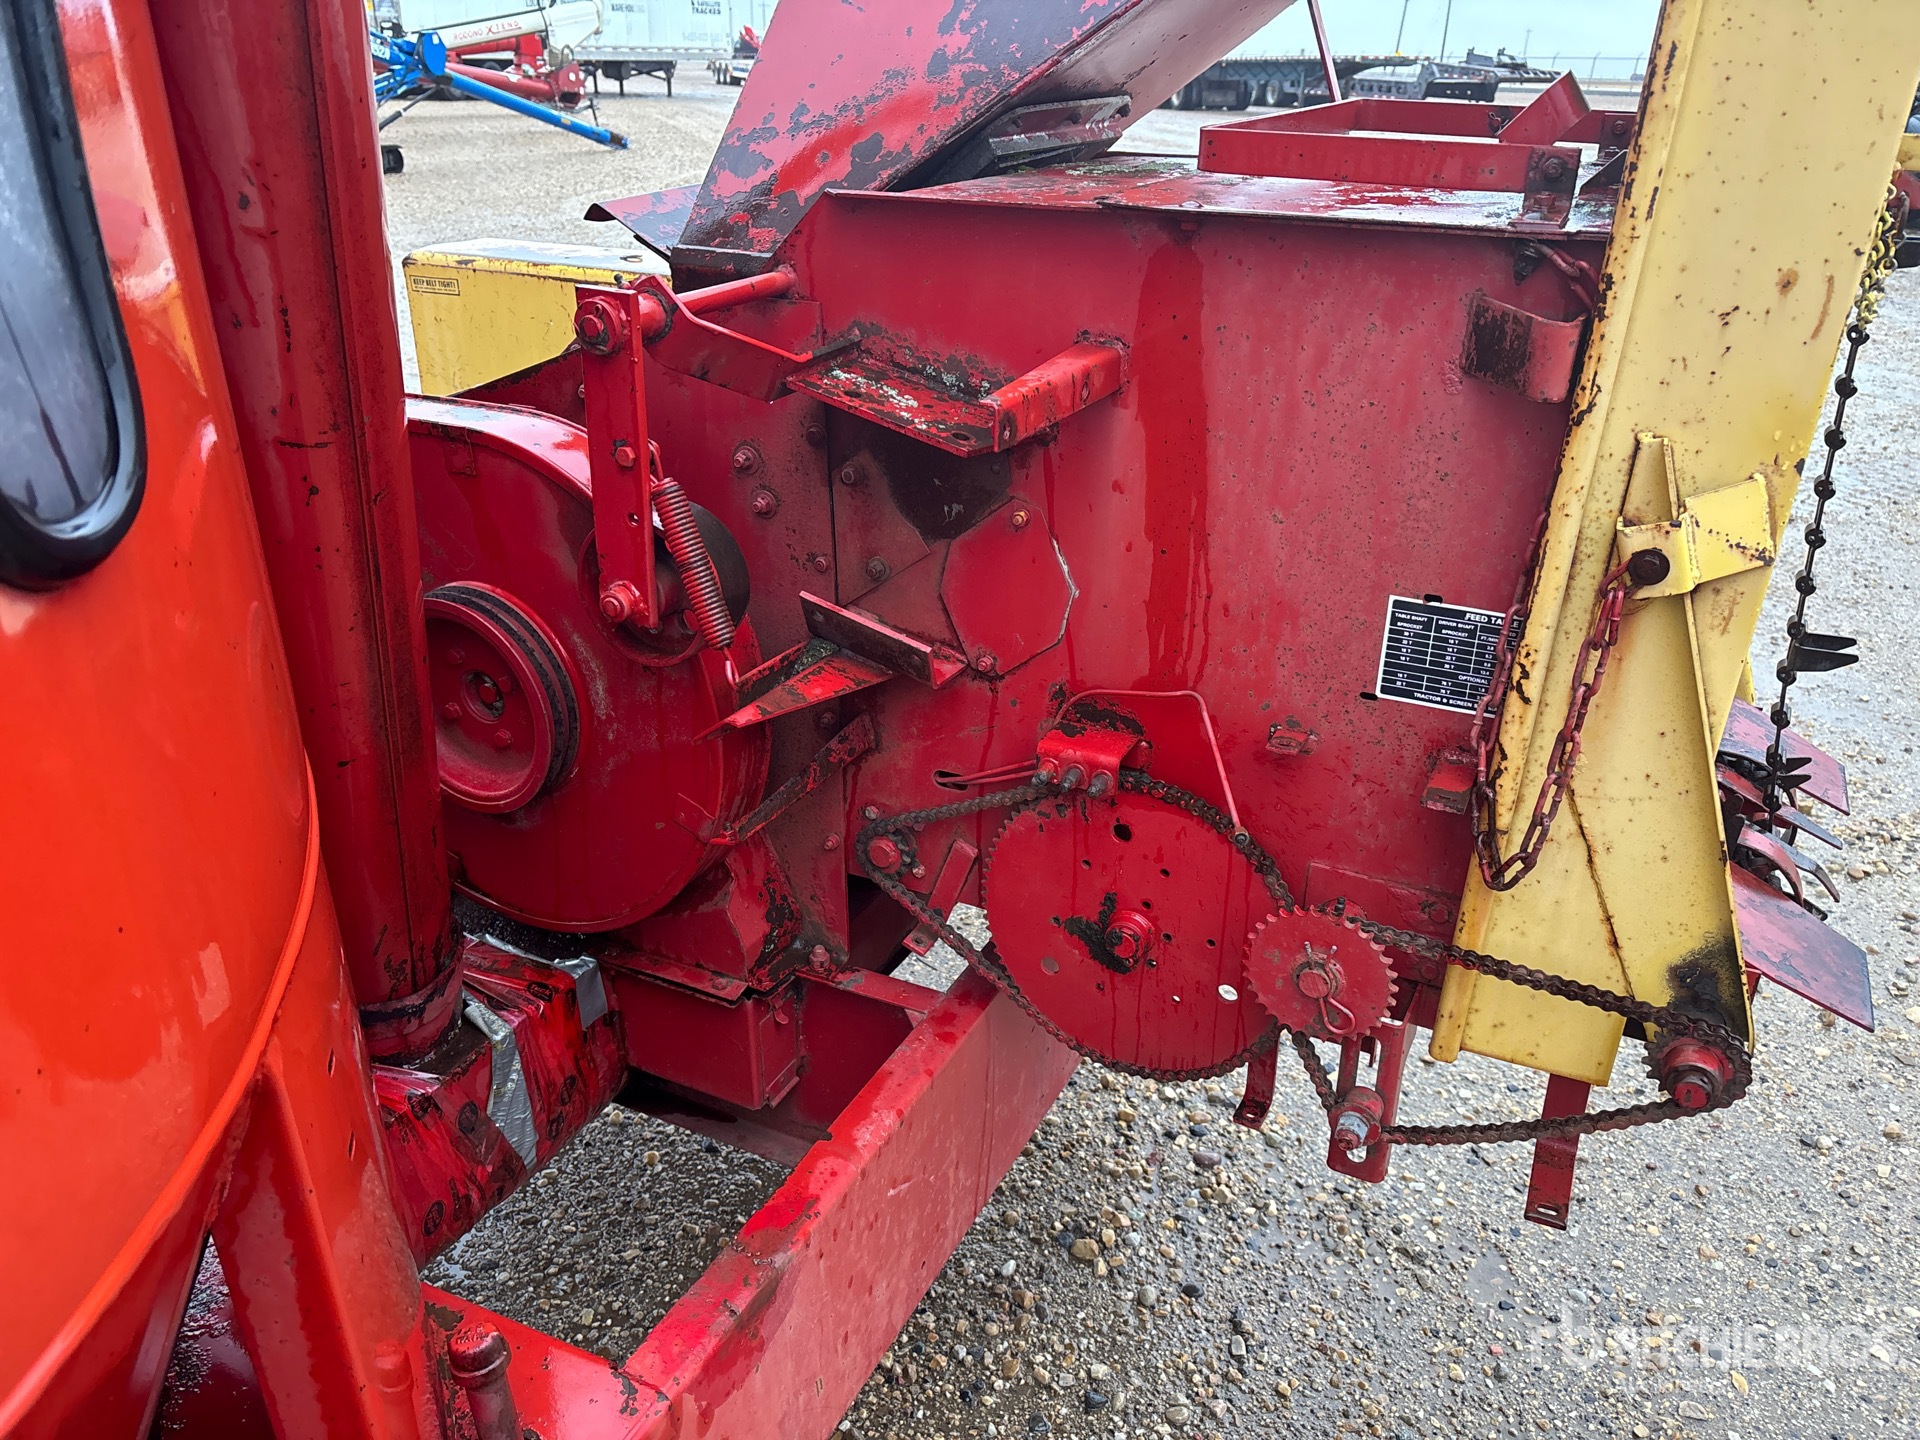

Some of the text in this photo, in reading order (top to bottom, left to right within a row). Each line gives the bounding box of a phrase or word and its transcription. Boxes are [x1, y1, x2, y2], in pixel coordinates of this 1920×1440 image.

[1395, 612, 1410, 620] TABLE
[1465, 612, 1488, 623] FEED
[1397, 621, 1423, 630] SPROCKET
[1441, 629, 1468, 638] SPROCKET
[1458, 674, 1488, 685] OPTIONAL
[1413, 692, 1441, 702] TRACTOR
[1449, 698, 1473, 708] SCREEN
